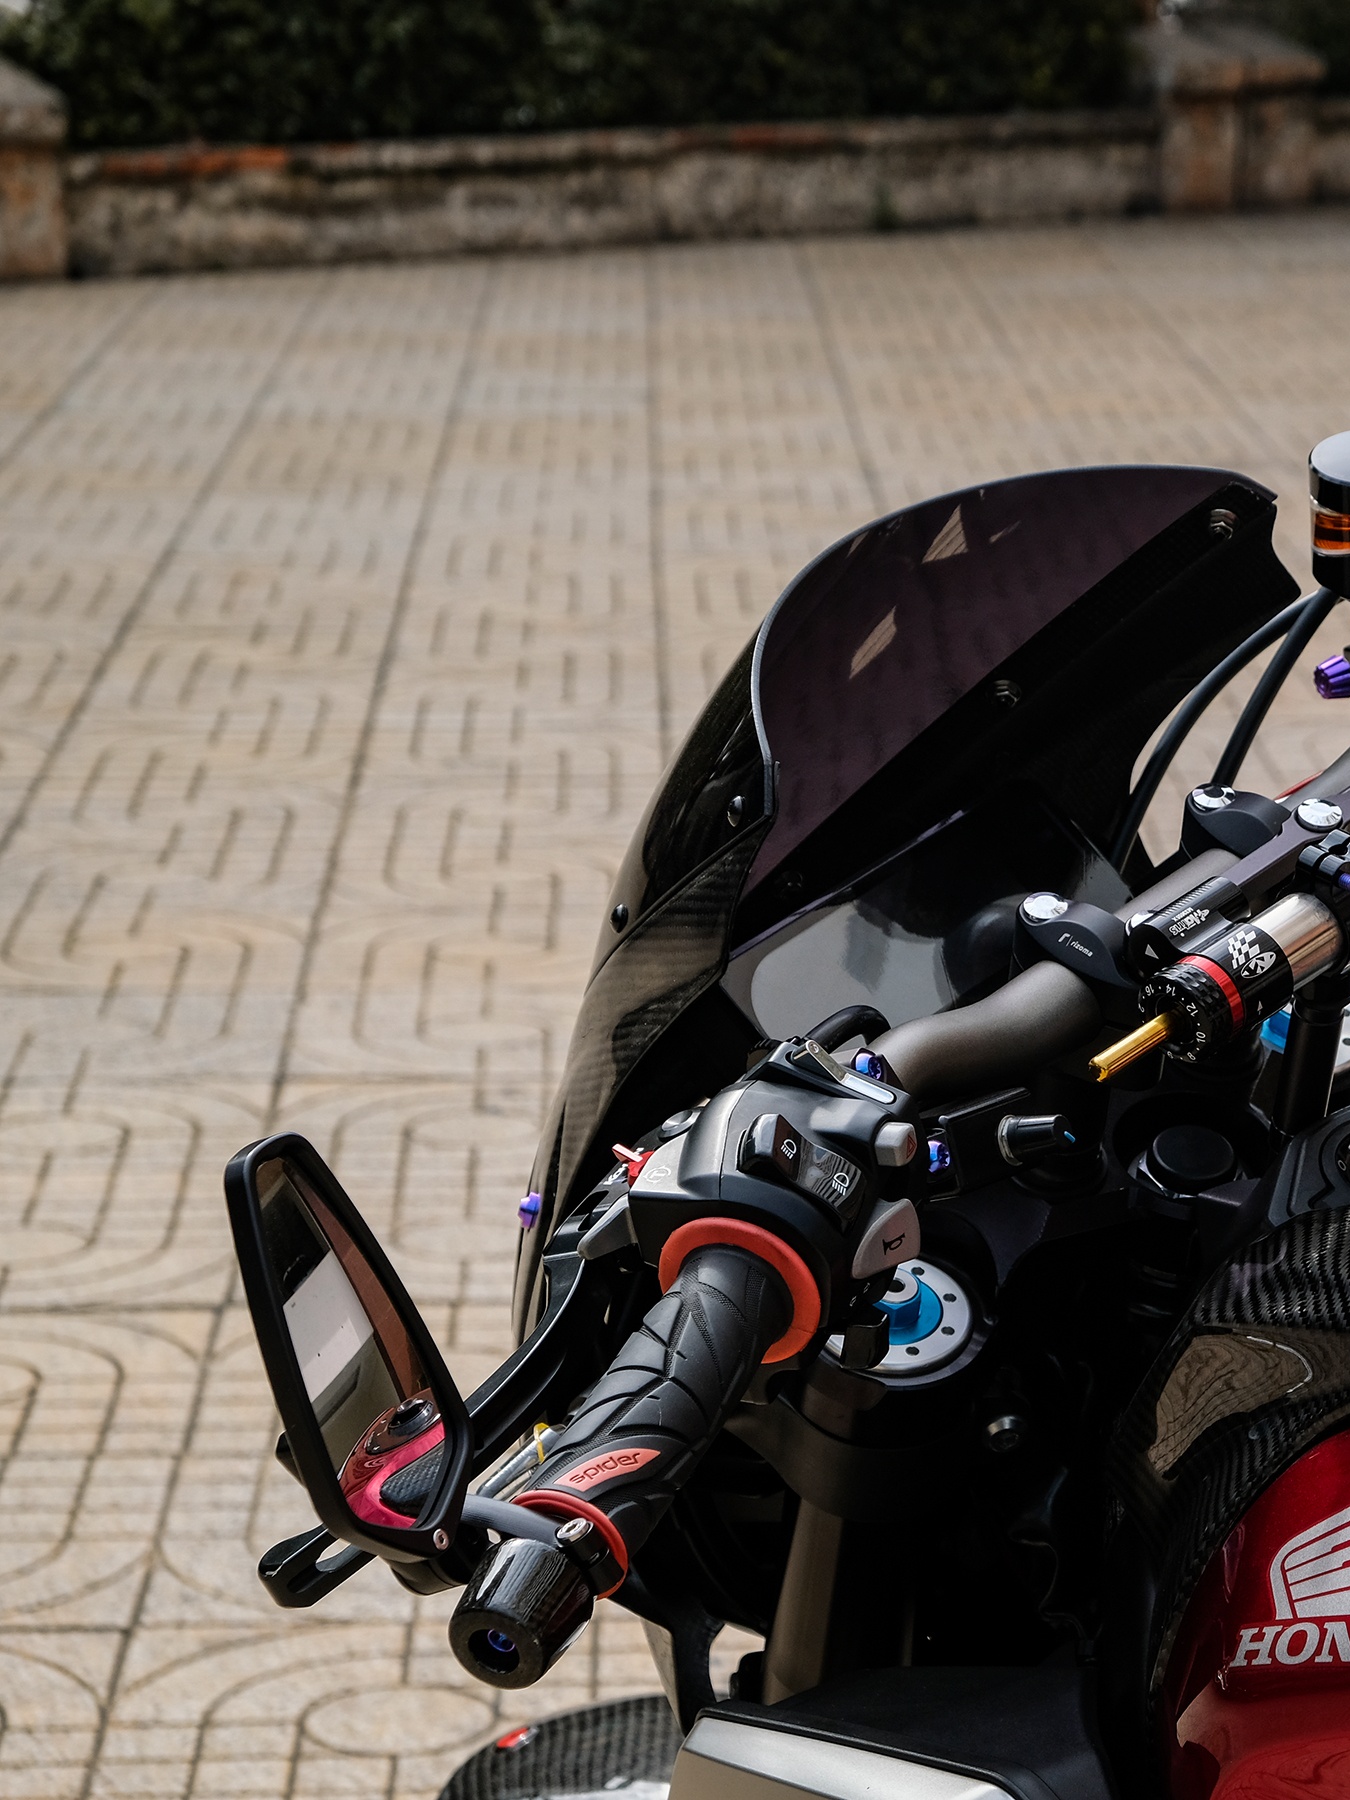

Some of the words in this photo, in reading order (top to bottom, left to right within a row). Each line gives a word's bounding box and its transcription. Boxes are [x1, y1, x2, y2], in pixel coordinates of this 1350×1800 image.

[1070, 941, 1094, 958] rizoma
[1144, 983, 1155, 997] 16
[1165, 983, 1177, 997] 14
[1186, 1002, 1199, 1018] 12
[1195, 1030, 1206, 1043] 10
[1186, 1051, 1196, 1061] 8
[569, 1452, 641, 1484] spider
